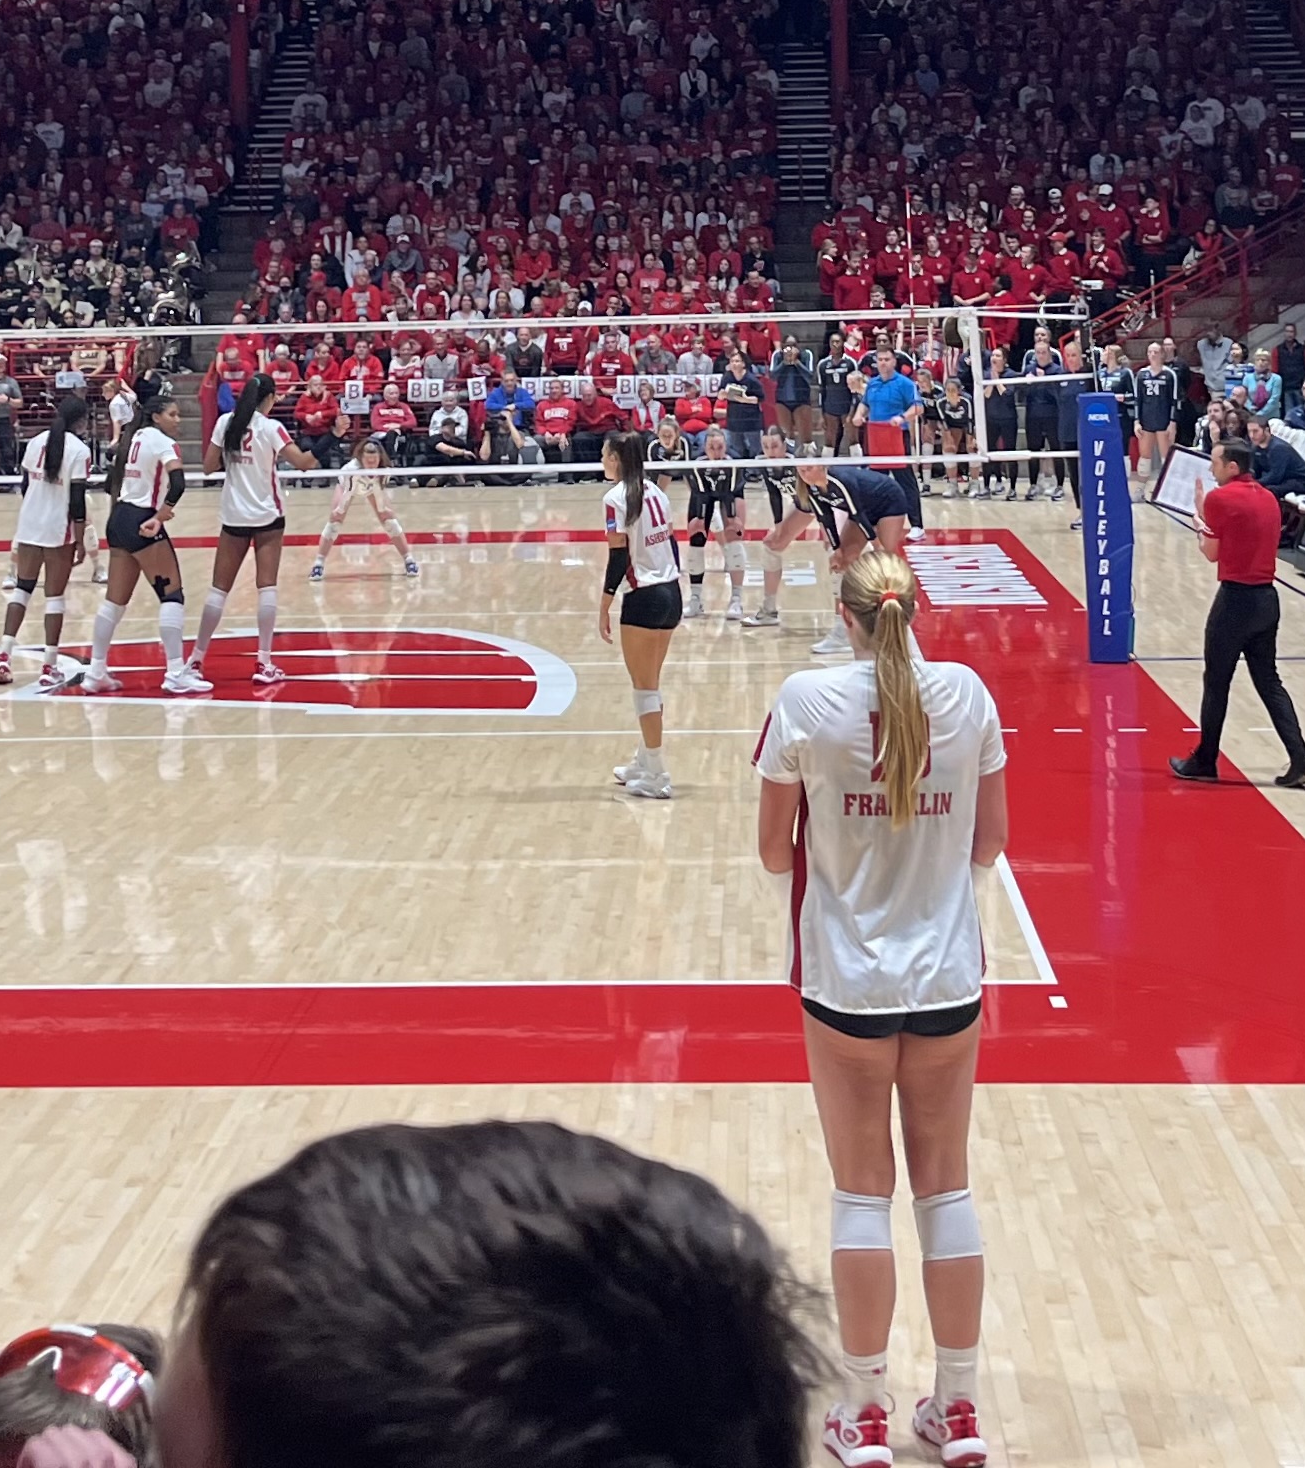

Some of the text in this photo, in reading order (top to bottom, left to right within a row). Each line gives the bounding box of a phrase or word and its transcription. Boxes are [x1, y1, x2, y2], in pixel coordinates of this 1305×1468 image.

[1146, 384, 1160, 396] 24
[644, 495, 666, 528] 11
[1093, 439, 1112, 637] VOLLEYBALL
[901, 543, 1048, 606] WISCONSIN
[843, 791, 953, 817] FRALIN
